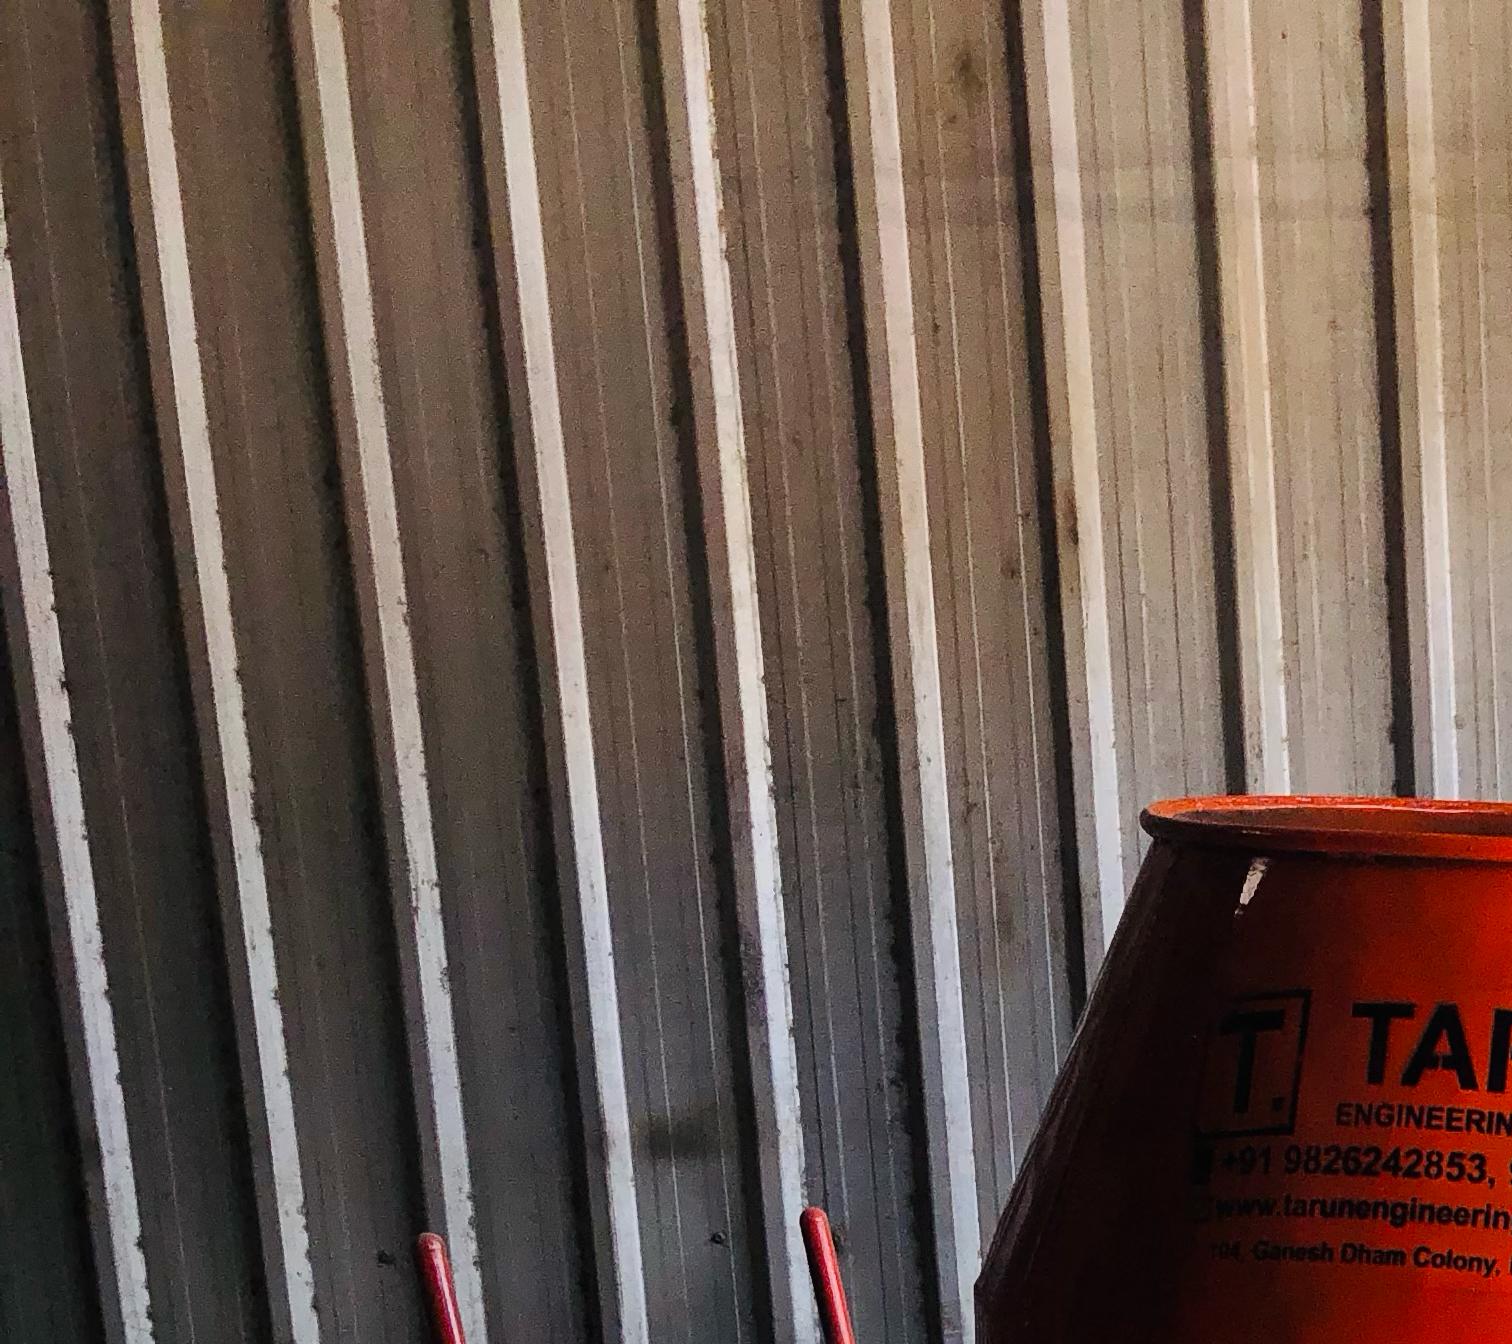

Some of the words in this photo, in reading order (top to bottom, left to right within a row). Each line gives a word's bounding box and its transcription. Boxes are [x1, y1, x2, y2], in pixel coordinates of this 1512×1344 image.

[1221, 1147, 1272, 1176] +91
[1283, 1145, 1495, 1189] 9826242853,
[1251, 1240, 1334, 1264] Ganesh
[1340, 1242, 1407, 1267] Dham
[1412, 1245, 1500, 1278] Colony,
